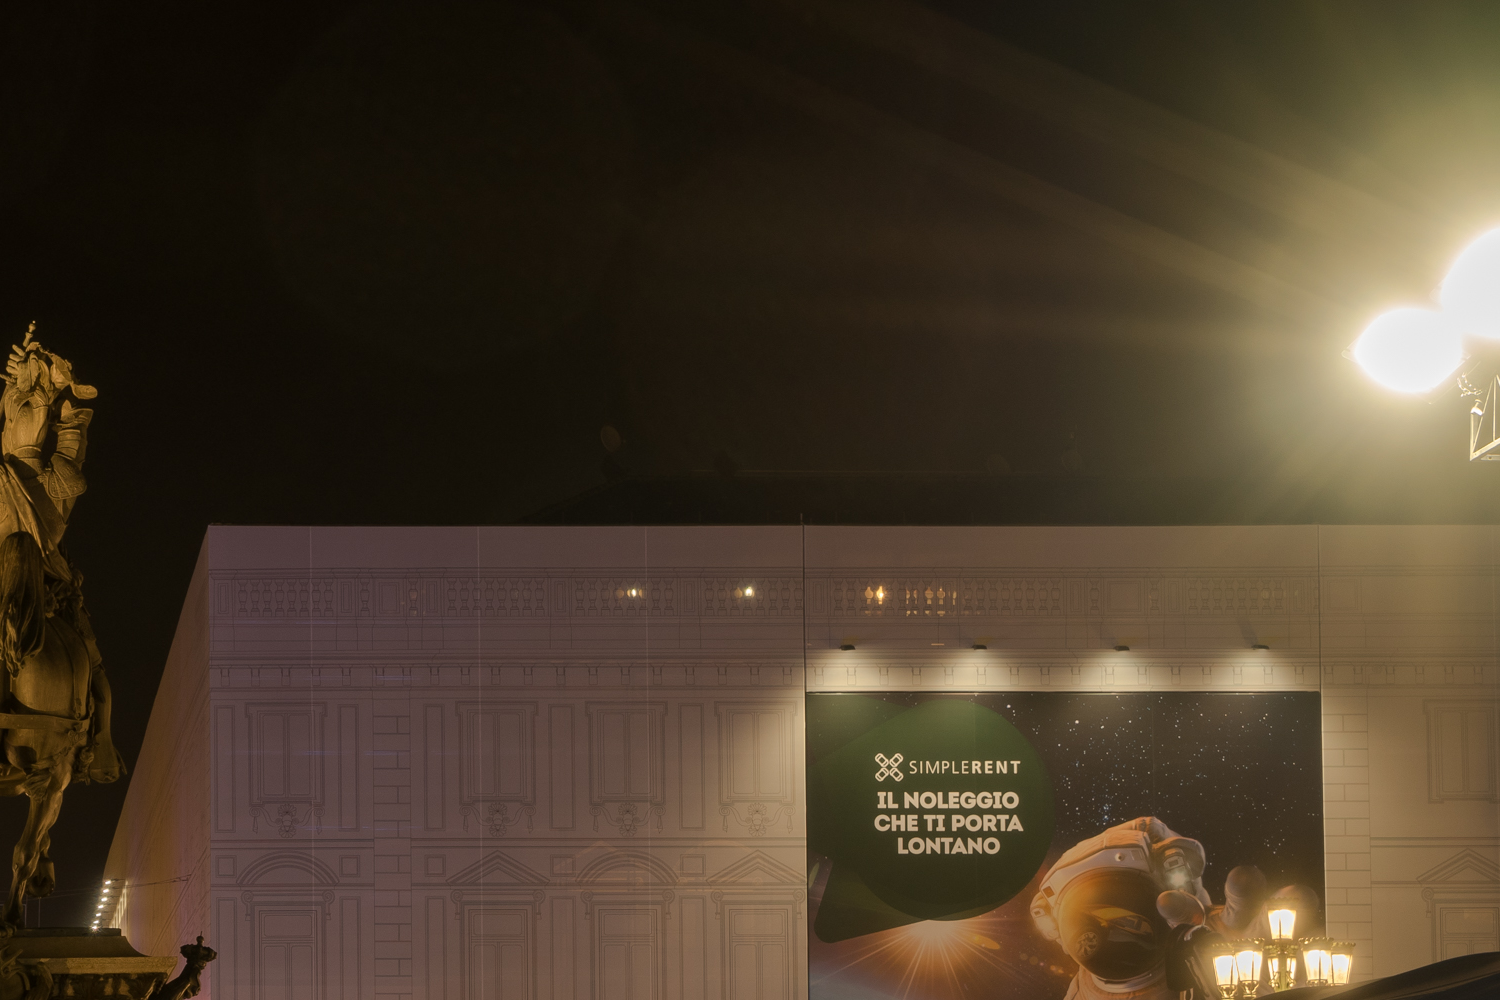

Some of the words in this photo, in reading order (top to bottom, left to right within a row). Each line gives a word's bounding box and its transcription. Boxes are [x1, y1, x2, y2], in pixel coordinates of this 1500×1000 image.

[908, 760, 1021, 775] SIMPLERENT
[877, 791, 899, 809] IL
[903, 791, 1020, 809] NOLEGGIO
[873, 814, 919, 832] CHE
[923, 814, 946, 832] TI
[951, 814, 1024, 832] PORTA
[897, 837, 1001, 855] LONTANO
